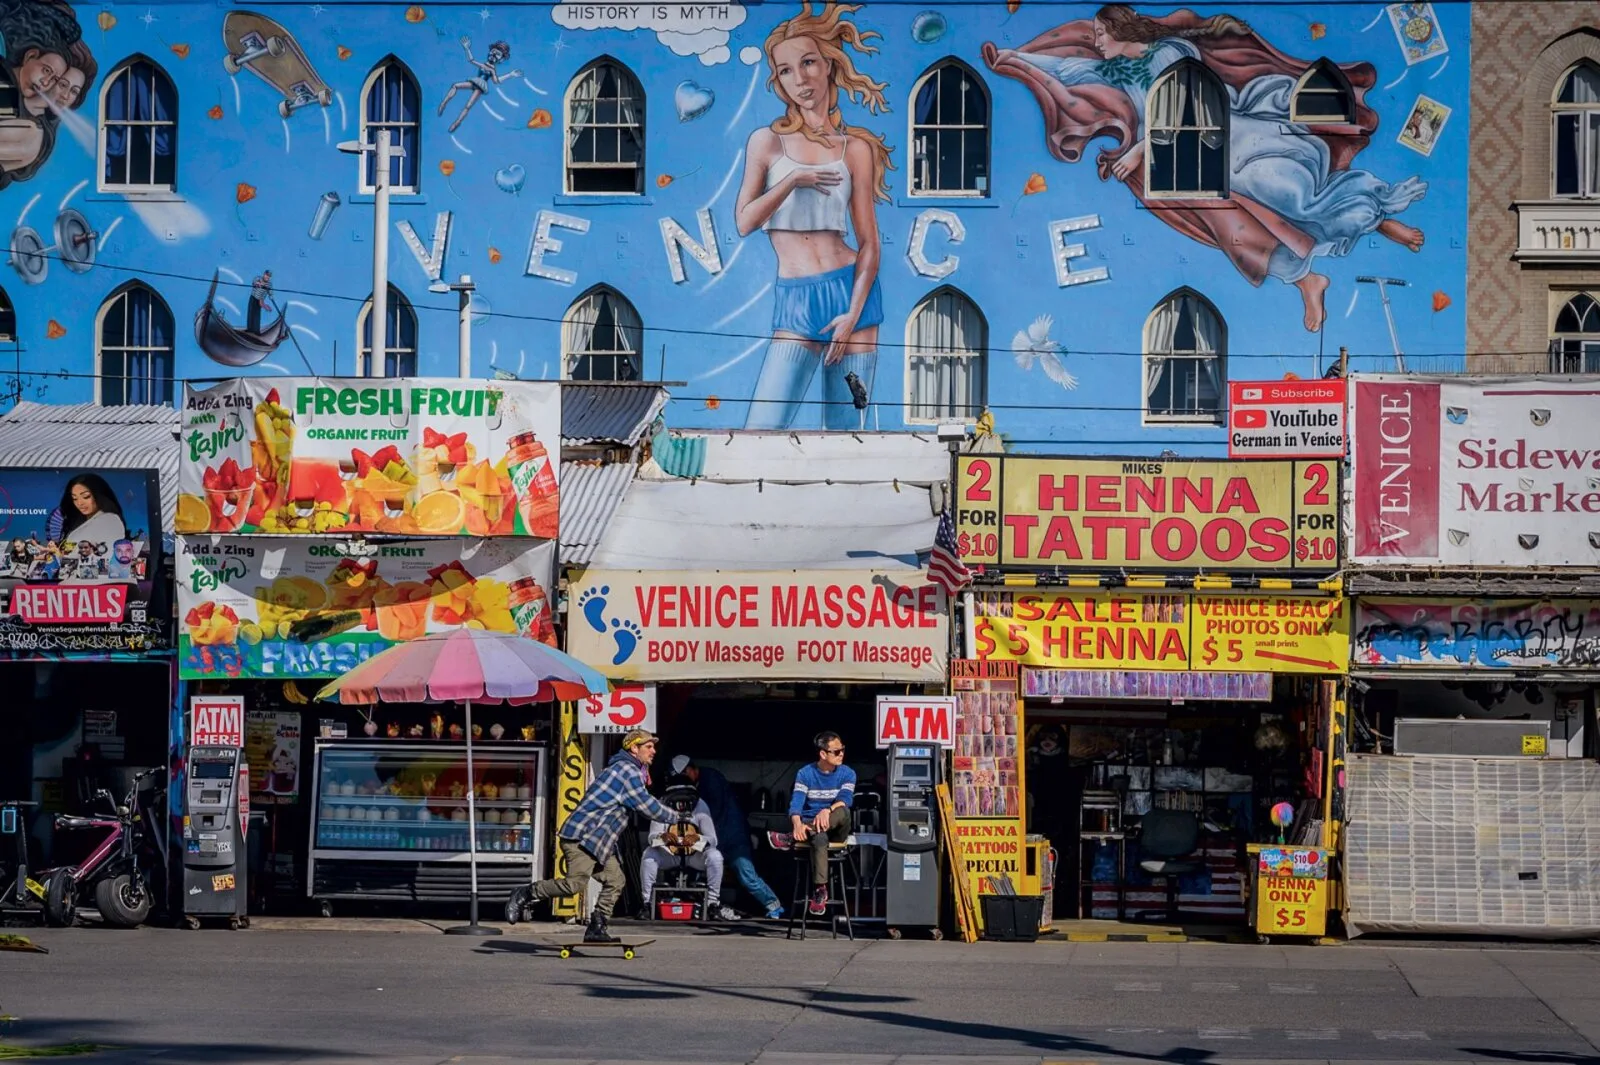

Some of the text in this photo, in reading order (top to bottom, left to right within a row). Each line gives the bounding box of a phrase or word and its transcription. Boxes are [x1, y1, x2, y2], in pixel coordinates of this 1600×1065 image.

[568, 6, 729, 20] HISTORY IS MYTH
[223, 392, 254, 411] Zing
[1271, 389, 1334, 398] Subscribe
[190, 411, 216, 425] with
[1270, 409, 1338, 427] YouTube
[307, 429, 409, 441] ORGANIC FRUIT
[1232, 431, 1343, 447] German in Venice
[1121, 463, 1163, 475] MIKES
[1379, 389, 1412, 548] VENICE
[965, 459, 993, 502] 2
[1303, 463, 1330, 506] 2
[1038, 474, 1261, 514] HENNA
[959, 510, 997, 526] FOR
[1296, 514, 1335, 531] FOR
[958, 532, 998, 560] $10
[1004, 514, 1291, 562] TATTOOS
[182, 544, 255, 557] Add a Zing
[381, 547, 426, 557] FRUIT
[1295, 536, 1336, 562] $10
[191, 557, 217, 566] with
[15, 588, 122, 619] RENTALS
[635, 585, 938, 629] VENICE MASSAGE
[1016, 596, 1137, 623] SALE
[1197, 598, 1343, 619] VENICE BEACH
[1206, 619, 1333, 636] PHOTOS ONLY
[1043, 625, 1187, 661] HENNA
[1255, 639, 1275, 647] small
[1277, 640, 1299, 649] prints
[648, 641, 933, 669] BODY Massage FOOT Massage
[952, 661, 1018, 678] BEST DEAL
[195, 707, 240, 733] ATM
[881, 707, 949, 740] ATM
[196, 734, 240, 746] HERE
[218, 750, 236, 758] ATM
[904, 748, 926, 756] ATM
[956, 825, 1018, 837] HENNA
[965, 859, 1019, 873] PECIAL
[1294, 854, 1307, 864] $10
[1267, 877, 1316, 891] HENNA
[1269, 890, 1312, 904] ONLY
[1276, 908, 1306, 928] $5
